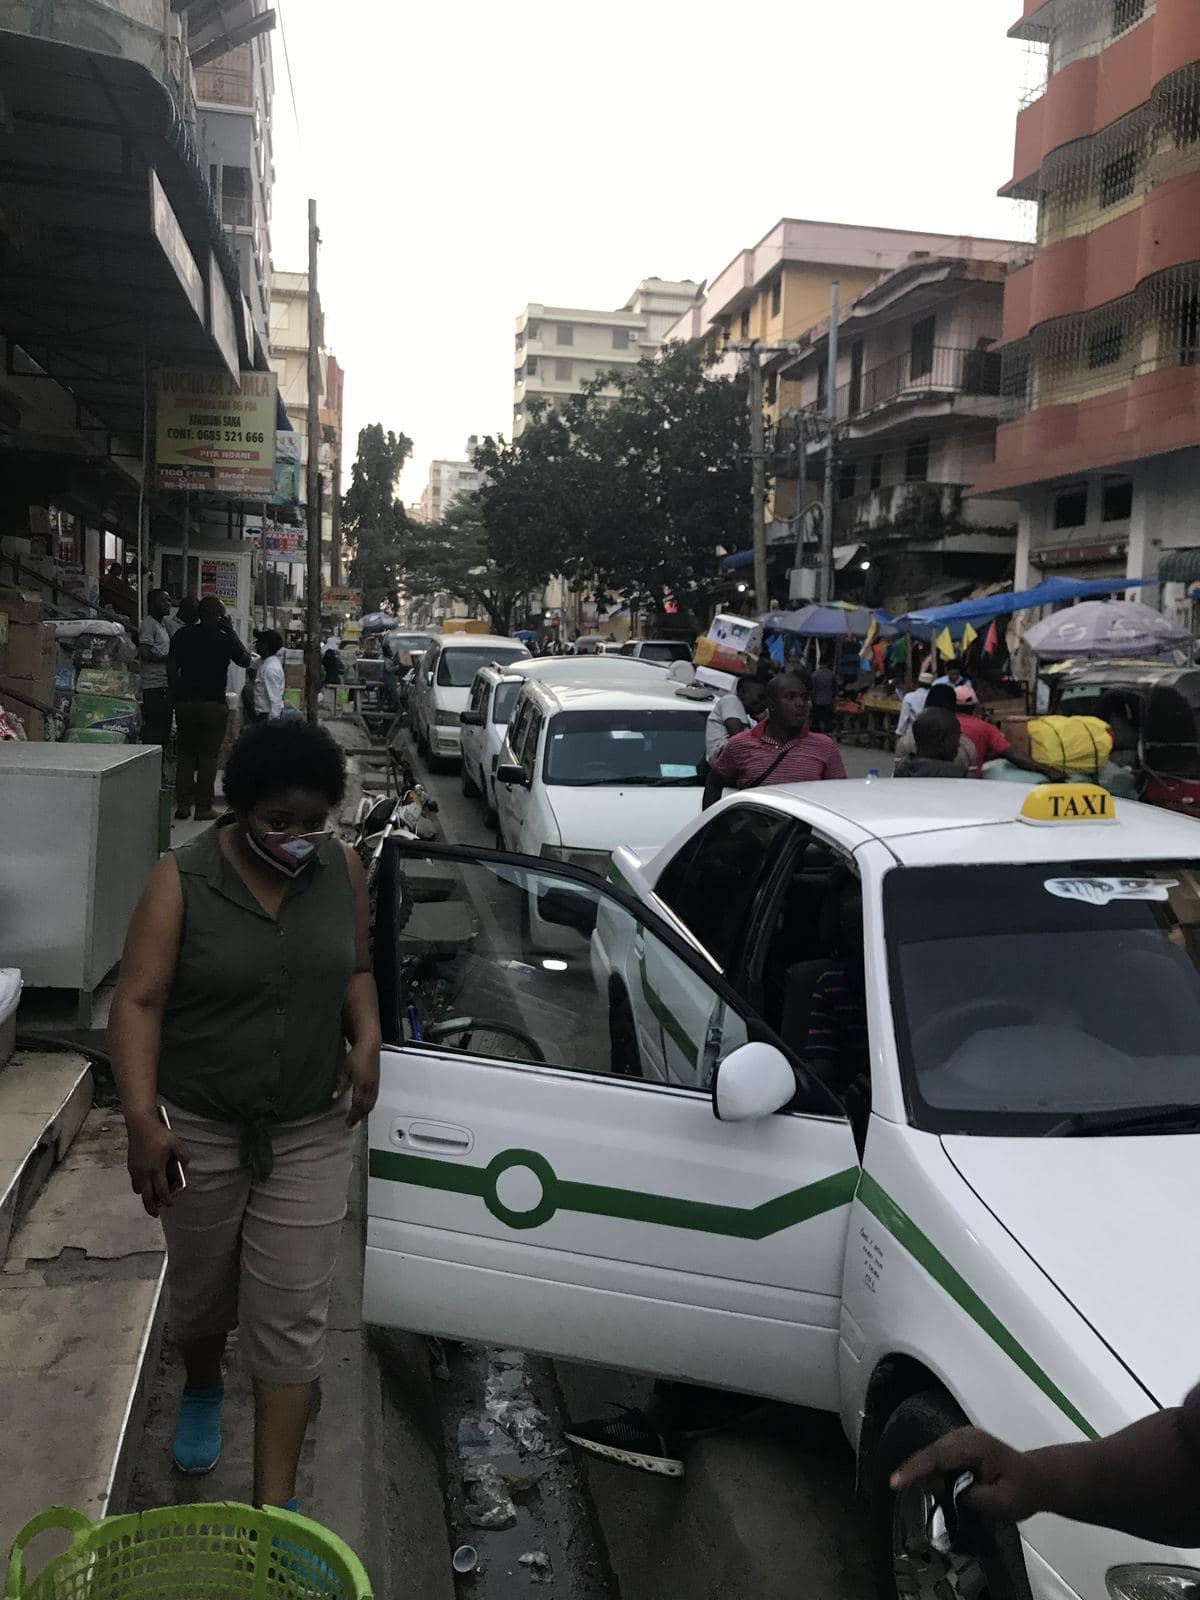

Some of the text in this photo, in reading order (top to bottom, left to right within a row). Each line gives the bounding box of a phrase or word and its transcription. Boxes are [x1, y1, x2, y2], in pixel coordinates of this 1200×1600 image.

[167, 428, 264, 443] CONT: 0685 321 666
[200, 450, 219, 458] PITA
[160, 469, 184, 477] TIGO
[1048, 794, 1107, 816] TAXI
